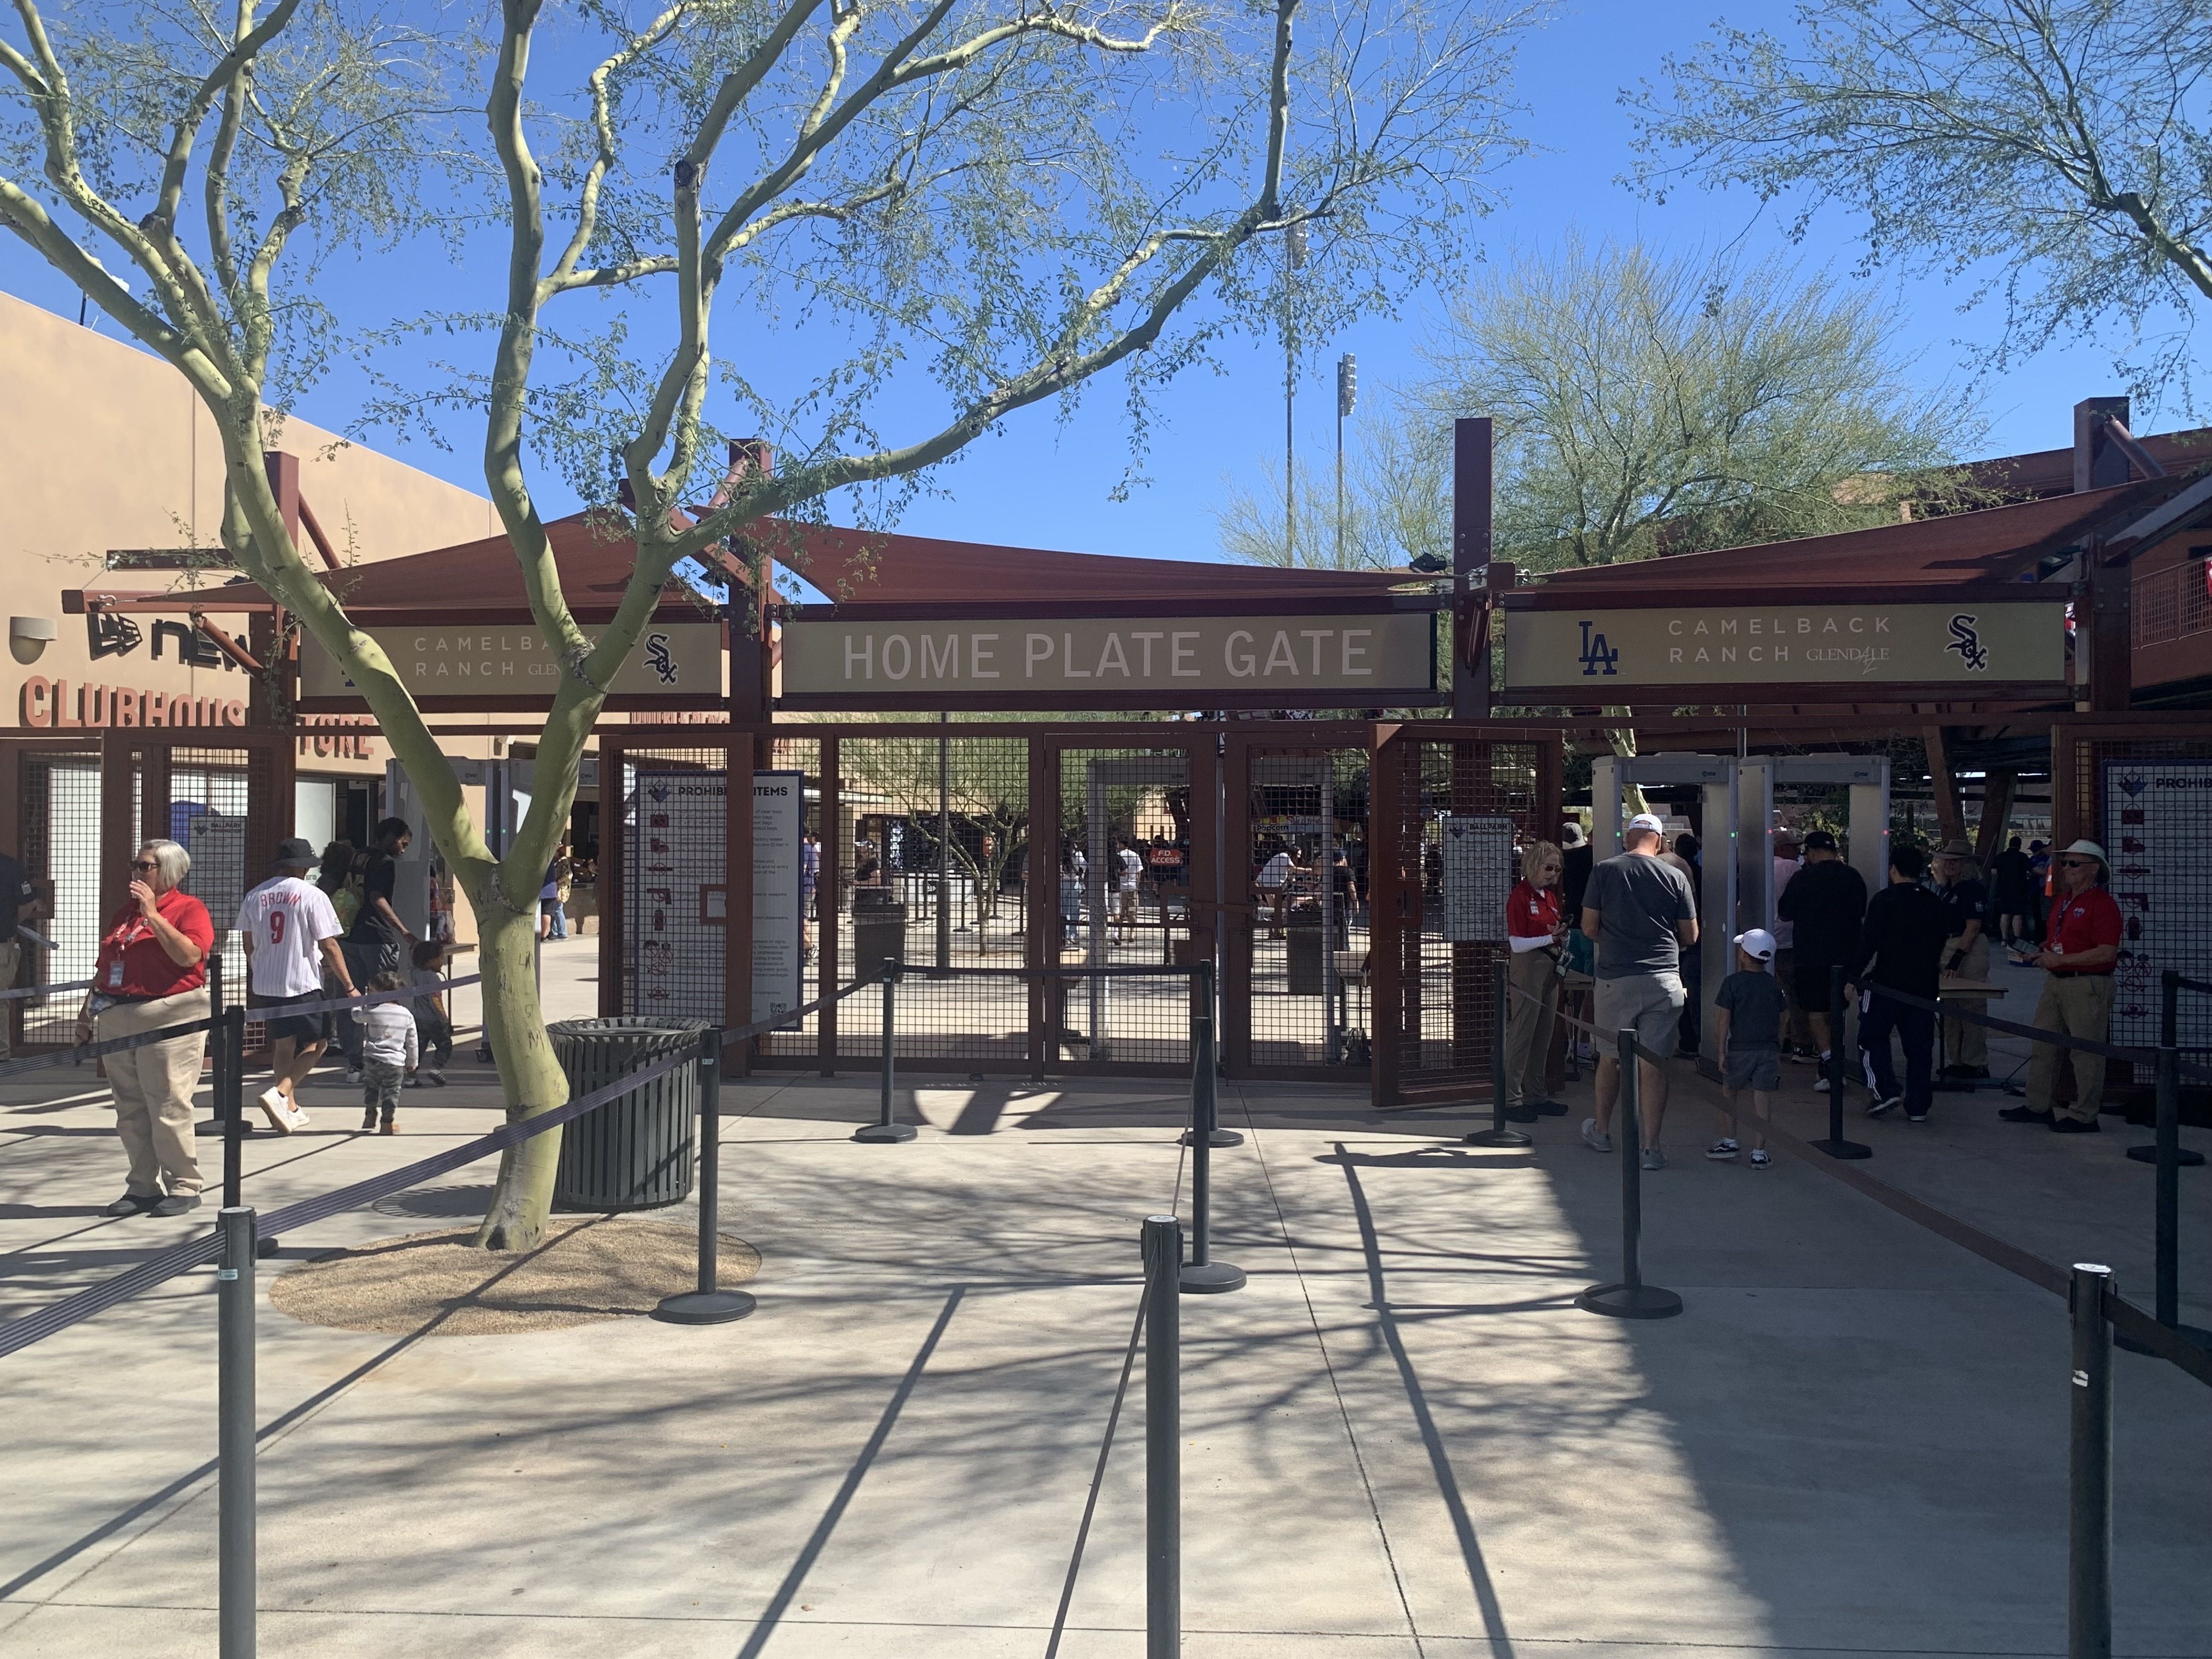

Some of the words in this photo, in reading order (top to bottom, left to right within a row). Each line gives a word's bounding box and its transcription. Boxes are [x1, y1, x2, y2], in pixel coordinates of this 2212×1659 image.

[1668, 617, 1890, 635] CAMELBACK
[844, 633, 1000, 680] HOME
[1025, 631, 1201, 678] PLATE
[1224, 629, 1373, 678] GATE
[1669, 646, 1788, 663] RANCH
[1806, 646, 1889, 662] GLENDALE
[416, 662, 514, 676] RANCH
[753, 786, 788, 796] ITEMS
[259, 890, 302, 907] BROWN
[270, 910, 285, 944] 9
